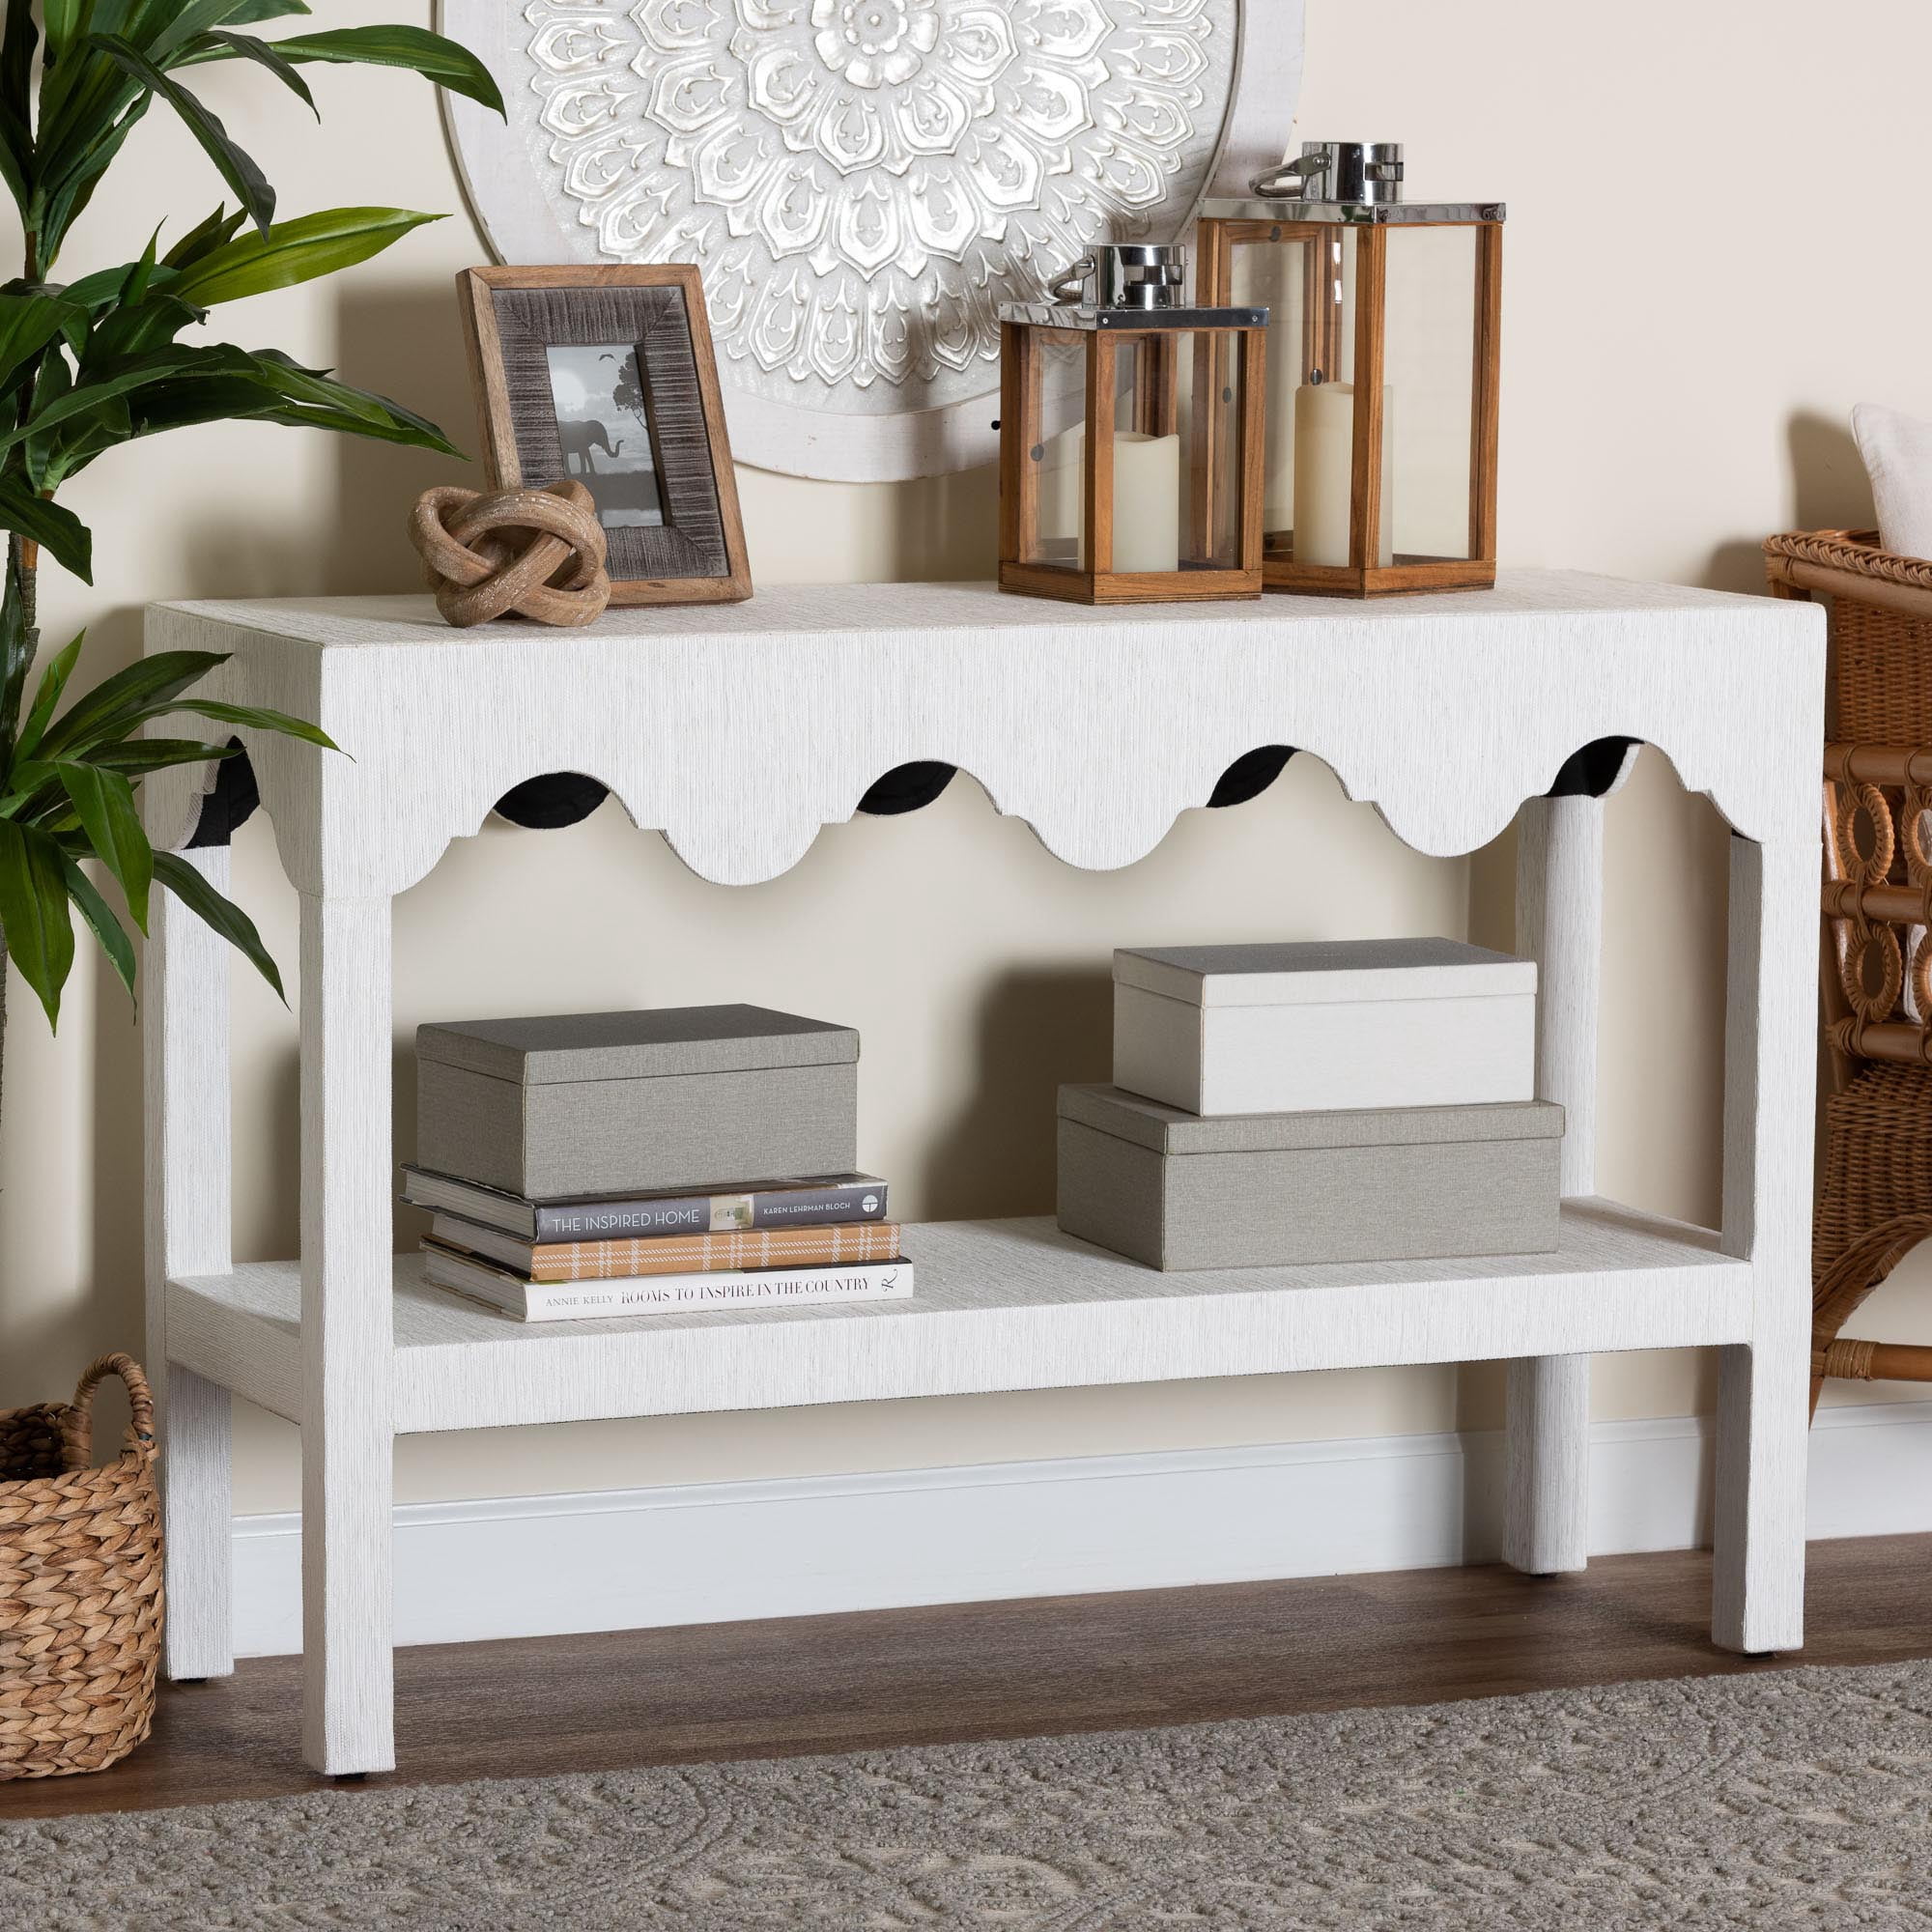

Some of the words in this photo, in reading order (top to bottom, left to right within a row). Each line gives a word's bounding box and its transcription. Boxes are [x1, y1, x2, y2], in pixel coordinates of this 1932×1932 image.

[763, 1206, 788, 1215] KAREN
[789, 1204, 824, 1213] LEHRMAN
[825, 1202, 851, 1210] BLOCH
[552, 1217, 582, 1233] THE
[584, 1212, 652, 1231] INSPIRED
[655, 1208, 700, 1226] HOME
[621, 1289, 670, 1304] ROOMS
[675, 1288, 694, 1301] TO
[699, 1283, 755, 1299] INSPIRE
[757, 1282, 772, 1296] IN
[773, 1280, 803, 1295] THE
[805, 1276, 870, 1293] COUNTRY
[545, 1295, 579, 1307] ANNIE
[582, 1294, 614, 1305] KELLY
